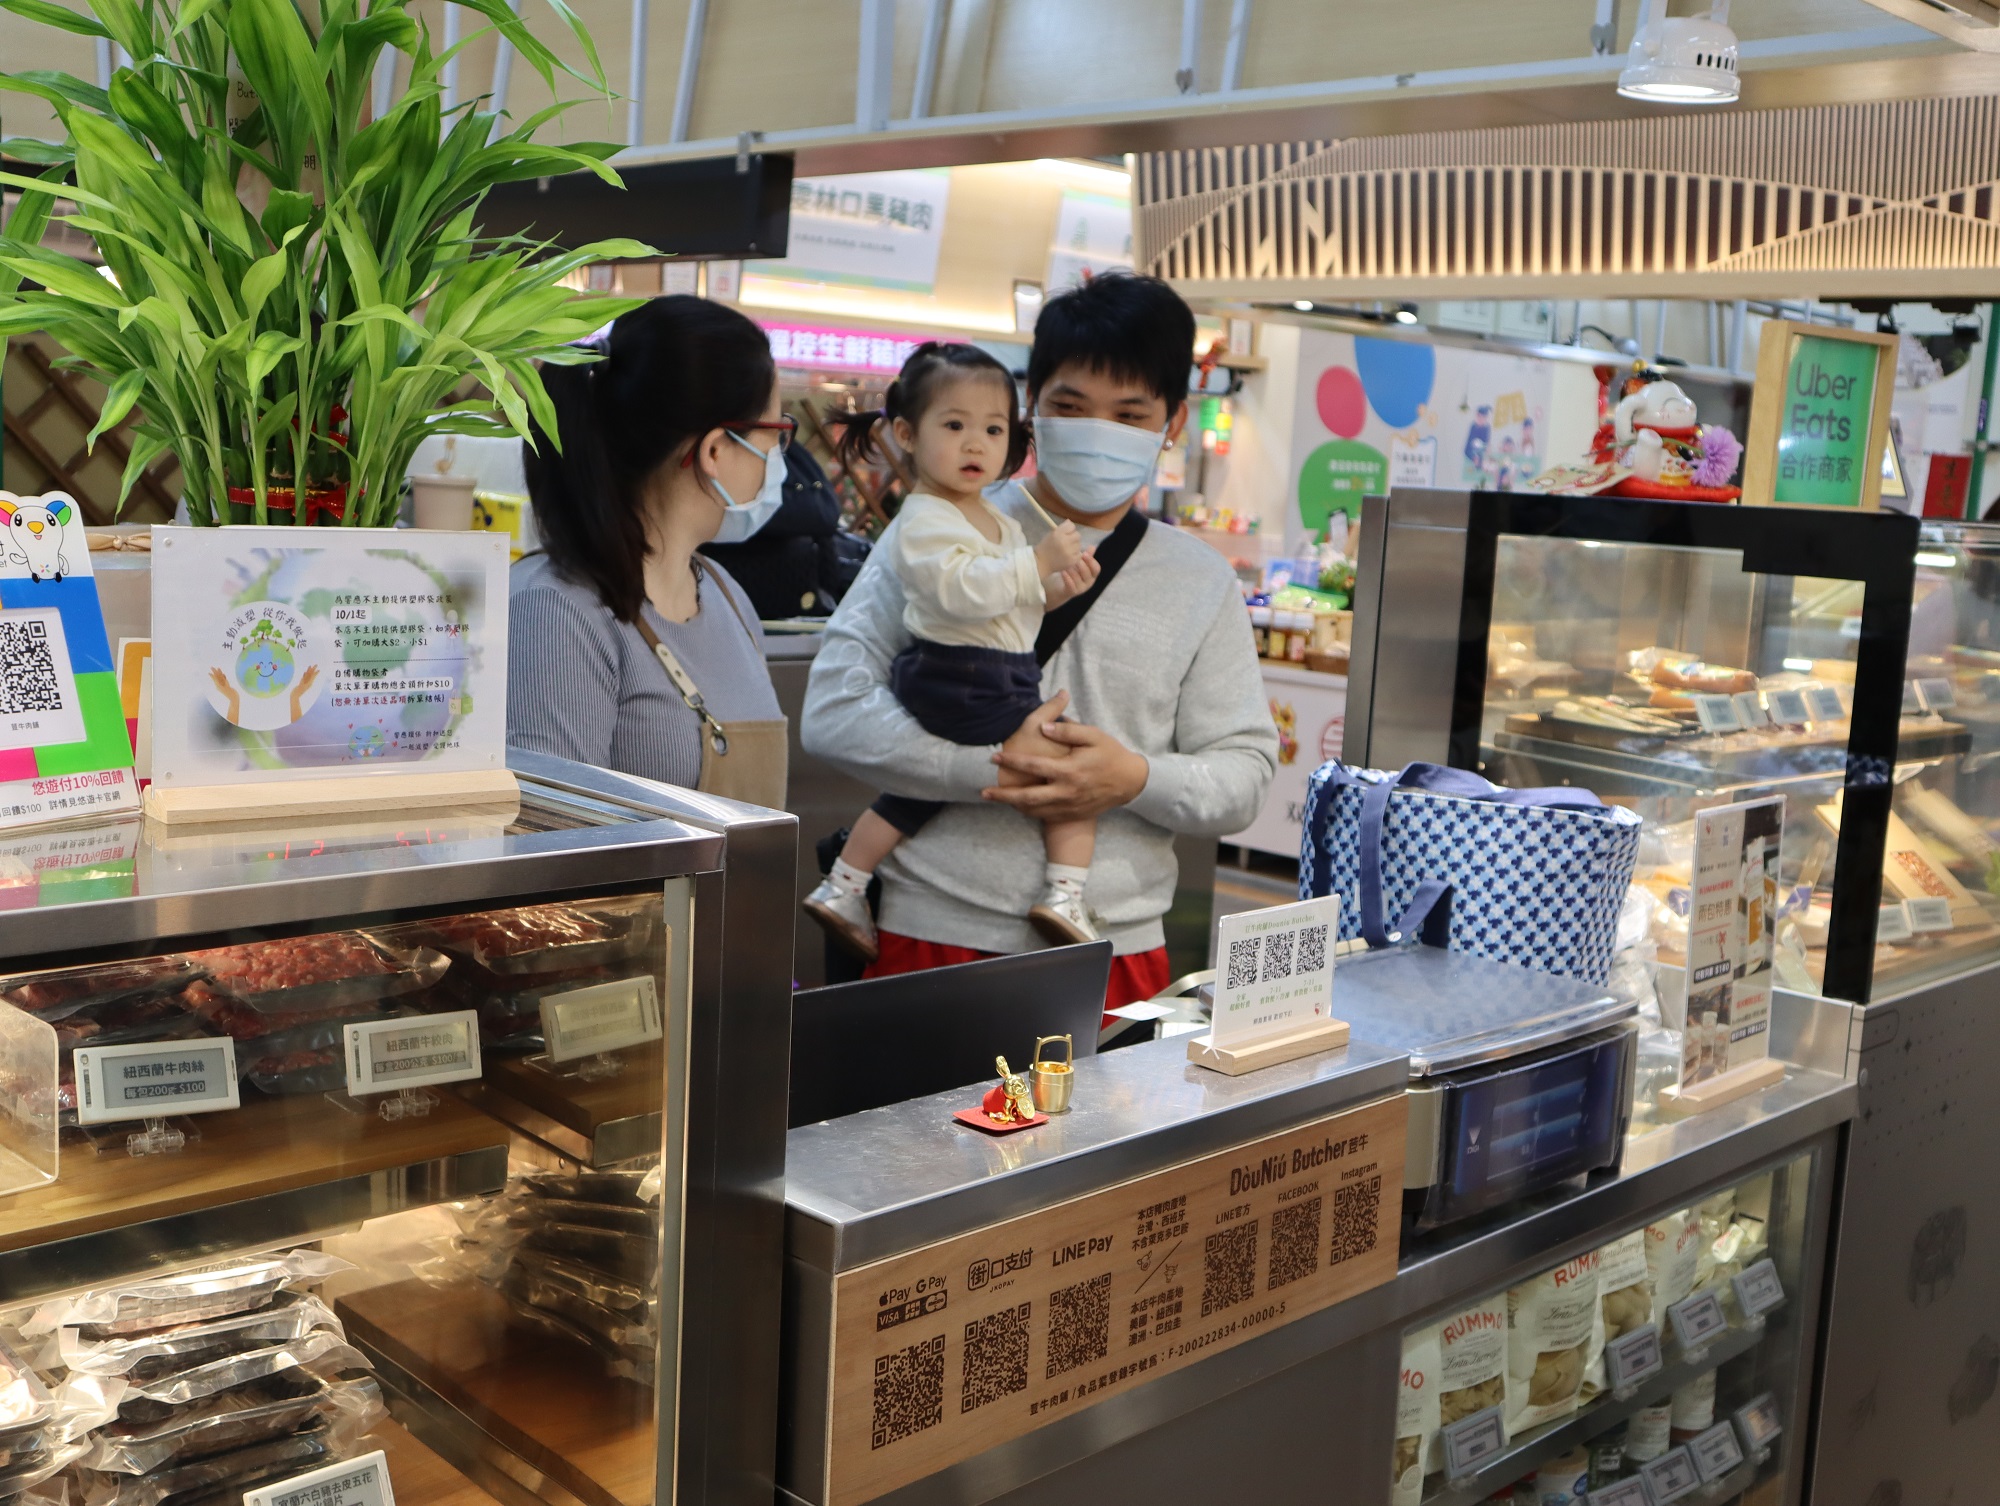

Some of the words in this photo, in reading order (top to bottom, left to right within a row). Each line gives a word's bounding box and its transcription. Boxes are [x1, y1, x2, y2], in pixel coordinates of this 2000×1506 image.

[1796, 361, 1857, 400] Uber
[1791, 404, 1851, 442] Eats
[1782, 453, 1853, 484] 合作商家
[335, 608, 367, 620] 10/1起
[32, 769, 125, 796] 悠遊付10%回饋
[48, 790, 121, 811] 詳情見悠遊卡官網
[386, 1032, 453, 1053] 紐西蘭牛絞肉
[123, 1060, 205, 1079] 紐西蘭牛肉絲
[179, 1081, 205, 1094] $100
[1292, 1138, 1348, 1174] Butcher
[1341, 1162, 1378, 1181] Instagram
[1277, 1181, 1320, 1204] FACEBOOK
[1215, 1203, 1251, 1225] LINE官方
[1052, 1243, 1086, 1267] LINE
[1089, 1235, 1113, 1256] Pay
[969, 1247, 1033, 1288] 街口支付
[889, 1286, 912, 1304] Pay
[929, 1275, 947, 1290] Pay
[879, 1310, 900, 1326] VISA
[1443, 1312, 1503, 1345] RUMMO
